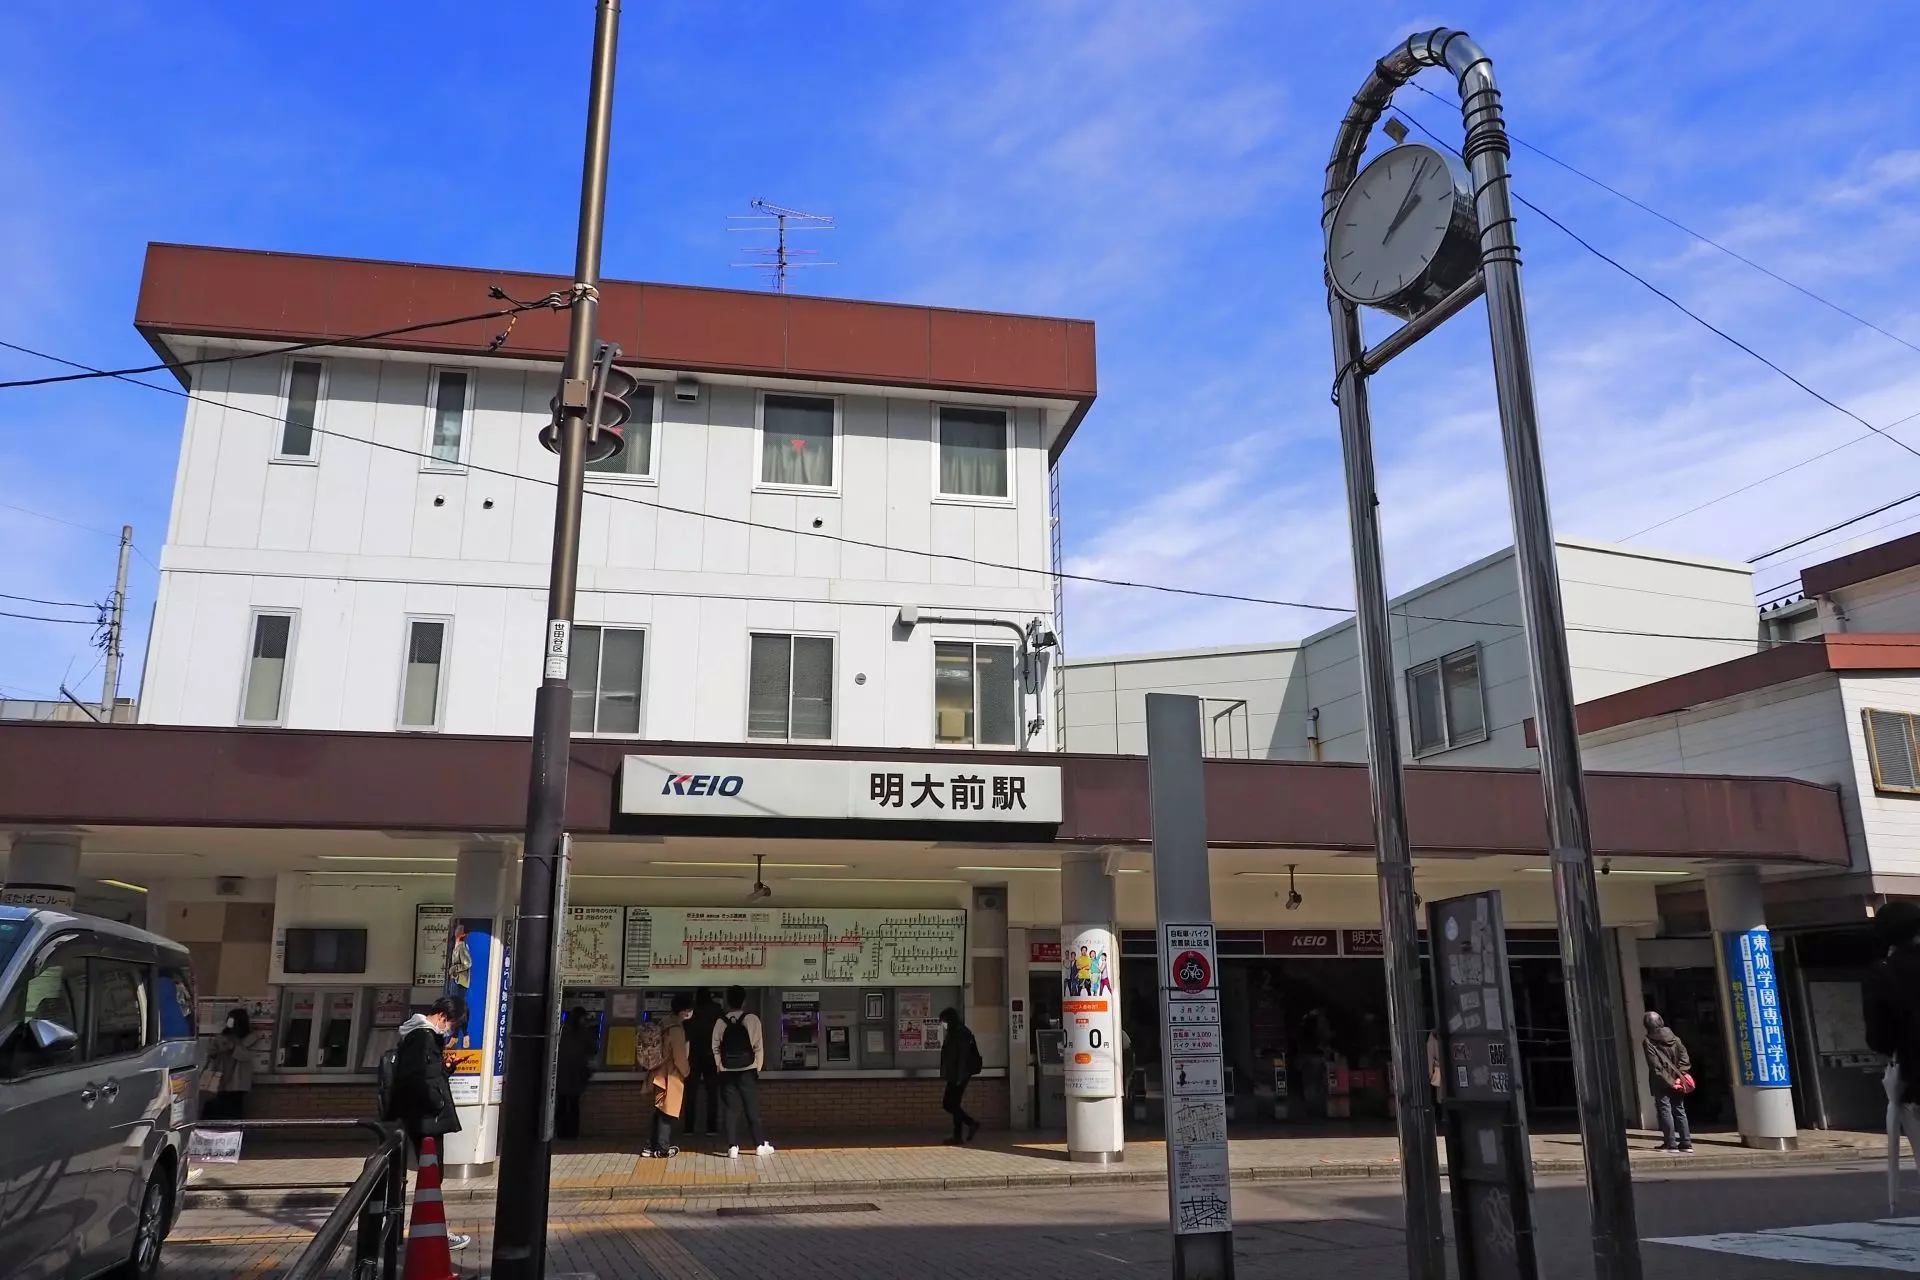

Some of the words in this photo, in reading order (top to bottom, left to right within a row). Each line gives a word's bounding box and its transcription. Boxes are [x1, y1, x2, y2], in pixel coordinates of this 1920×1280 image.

[552, 623, 565, 653] 世田谷区
[661, 773, 743, 797] KEIO
[869, 772, 1028, 812] 明大前駅
[1170, 929, 1209, 938] 自転車・バイク
[1170, 939, 1210, 947] 放置禁止区域
[1291, 935, 1328, 947] KEIO
[1751, 934, 1788, 1082] 東放学園専門学校
